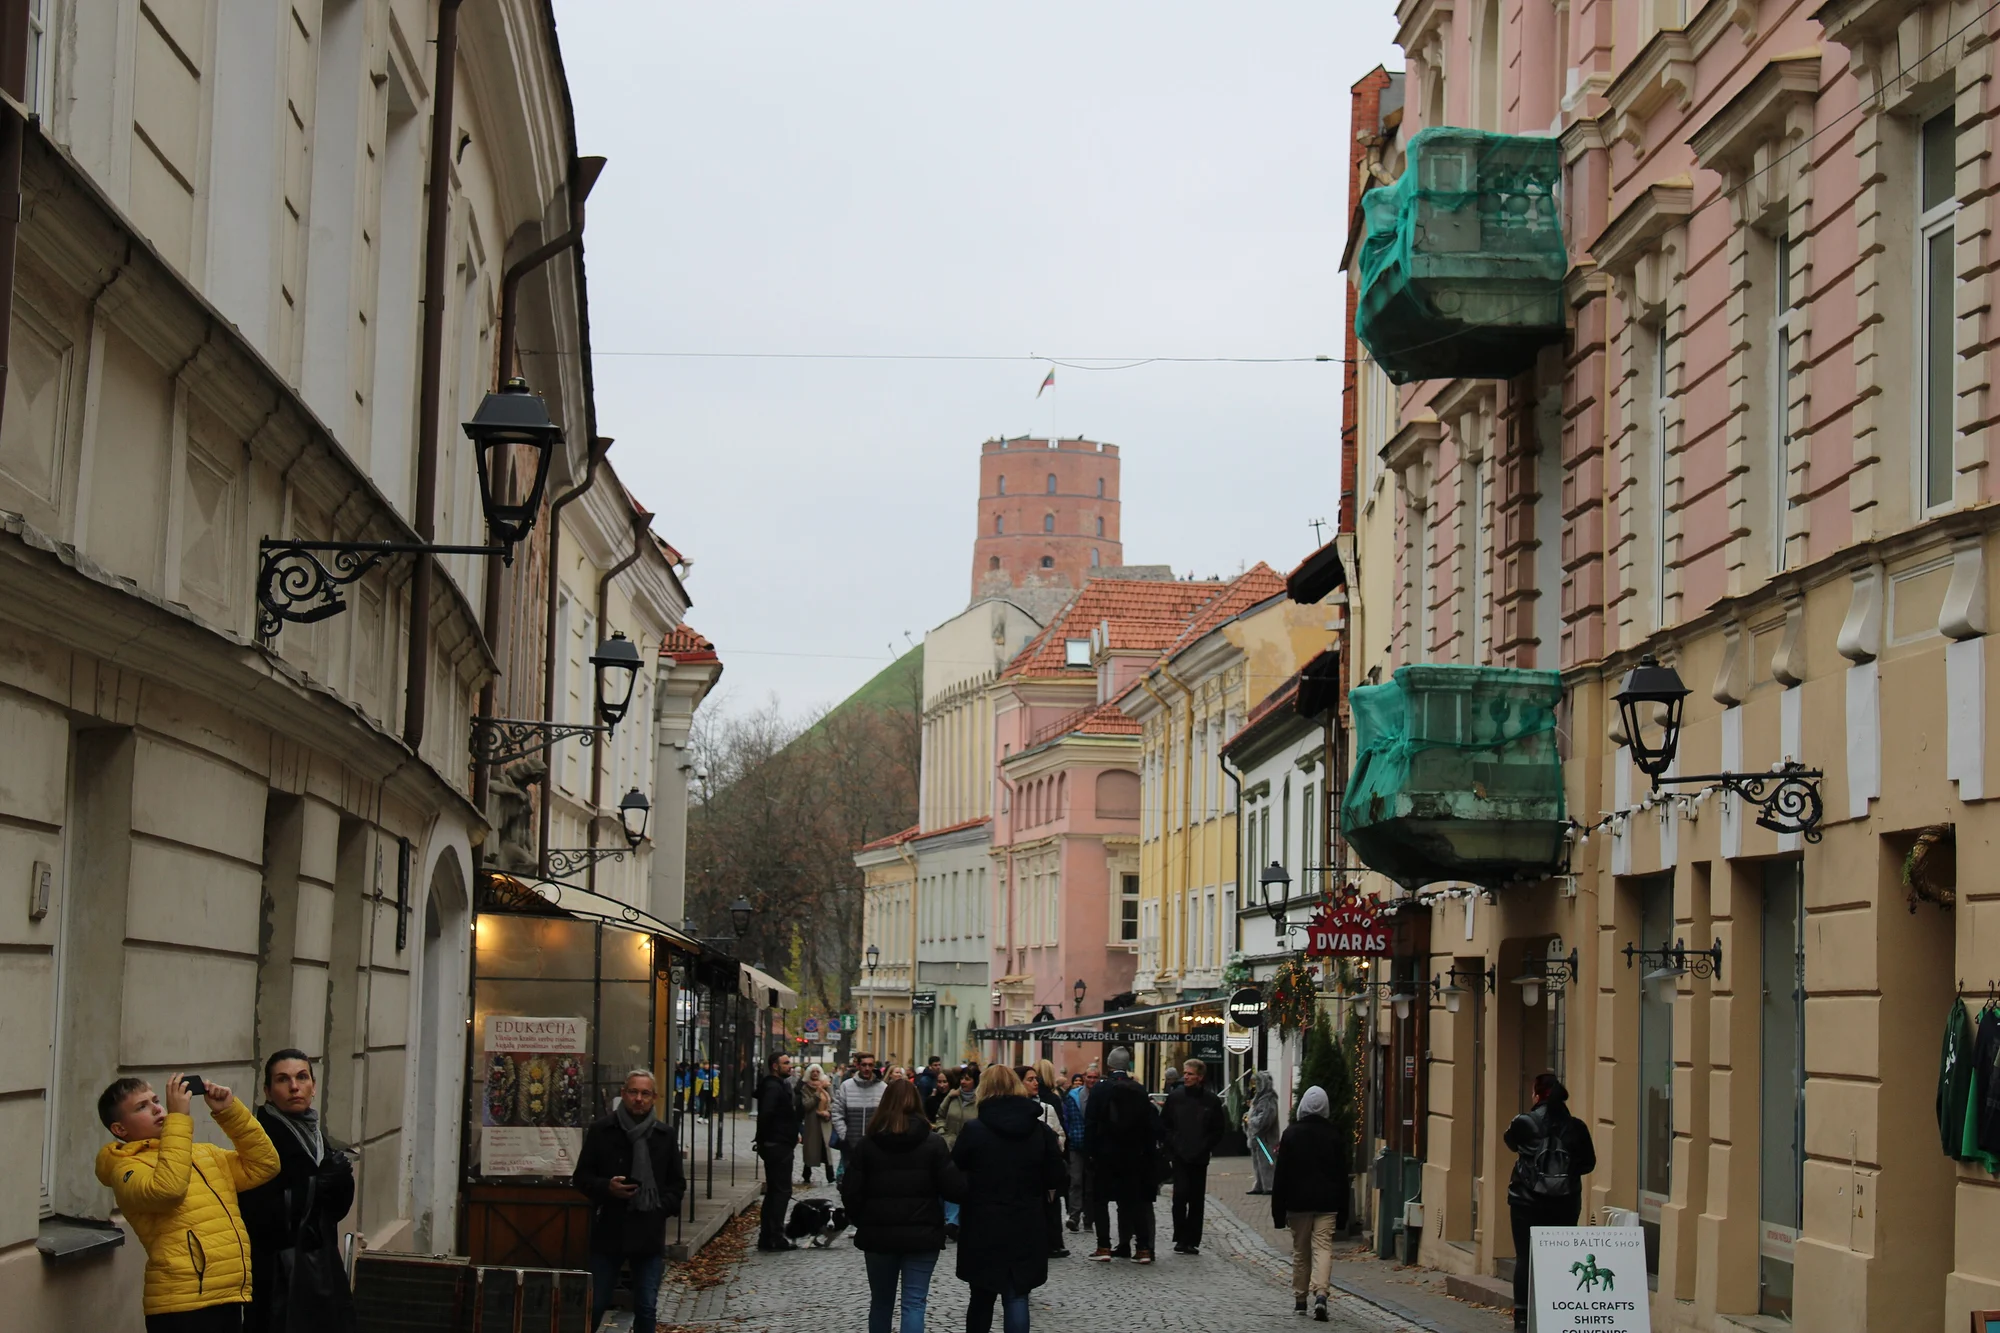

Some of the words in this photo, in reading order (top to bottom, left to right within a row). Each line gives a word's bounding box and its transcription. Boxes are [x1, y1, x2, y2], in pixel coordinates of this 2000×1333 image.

[1333, 912, 1372, 928] ETNO
[1316, 932, 1386, 951] DVARAS
[495, 1021, 576, 1036] EDUKACIJA
[1128, 1033, 1180, 1041] LITHUANIAN
[1184, 1033, 1220, 1042] CUISINE
[1573, 1238, 1612, 1248] BALTIC
[1552, 1301, 1589, 1310] LOCAL
[1591, 1301, 1635, 1311] CRAFTS
[1574, 1315, 1614, 1324] SHIRTS
